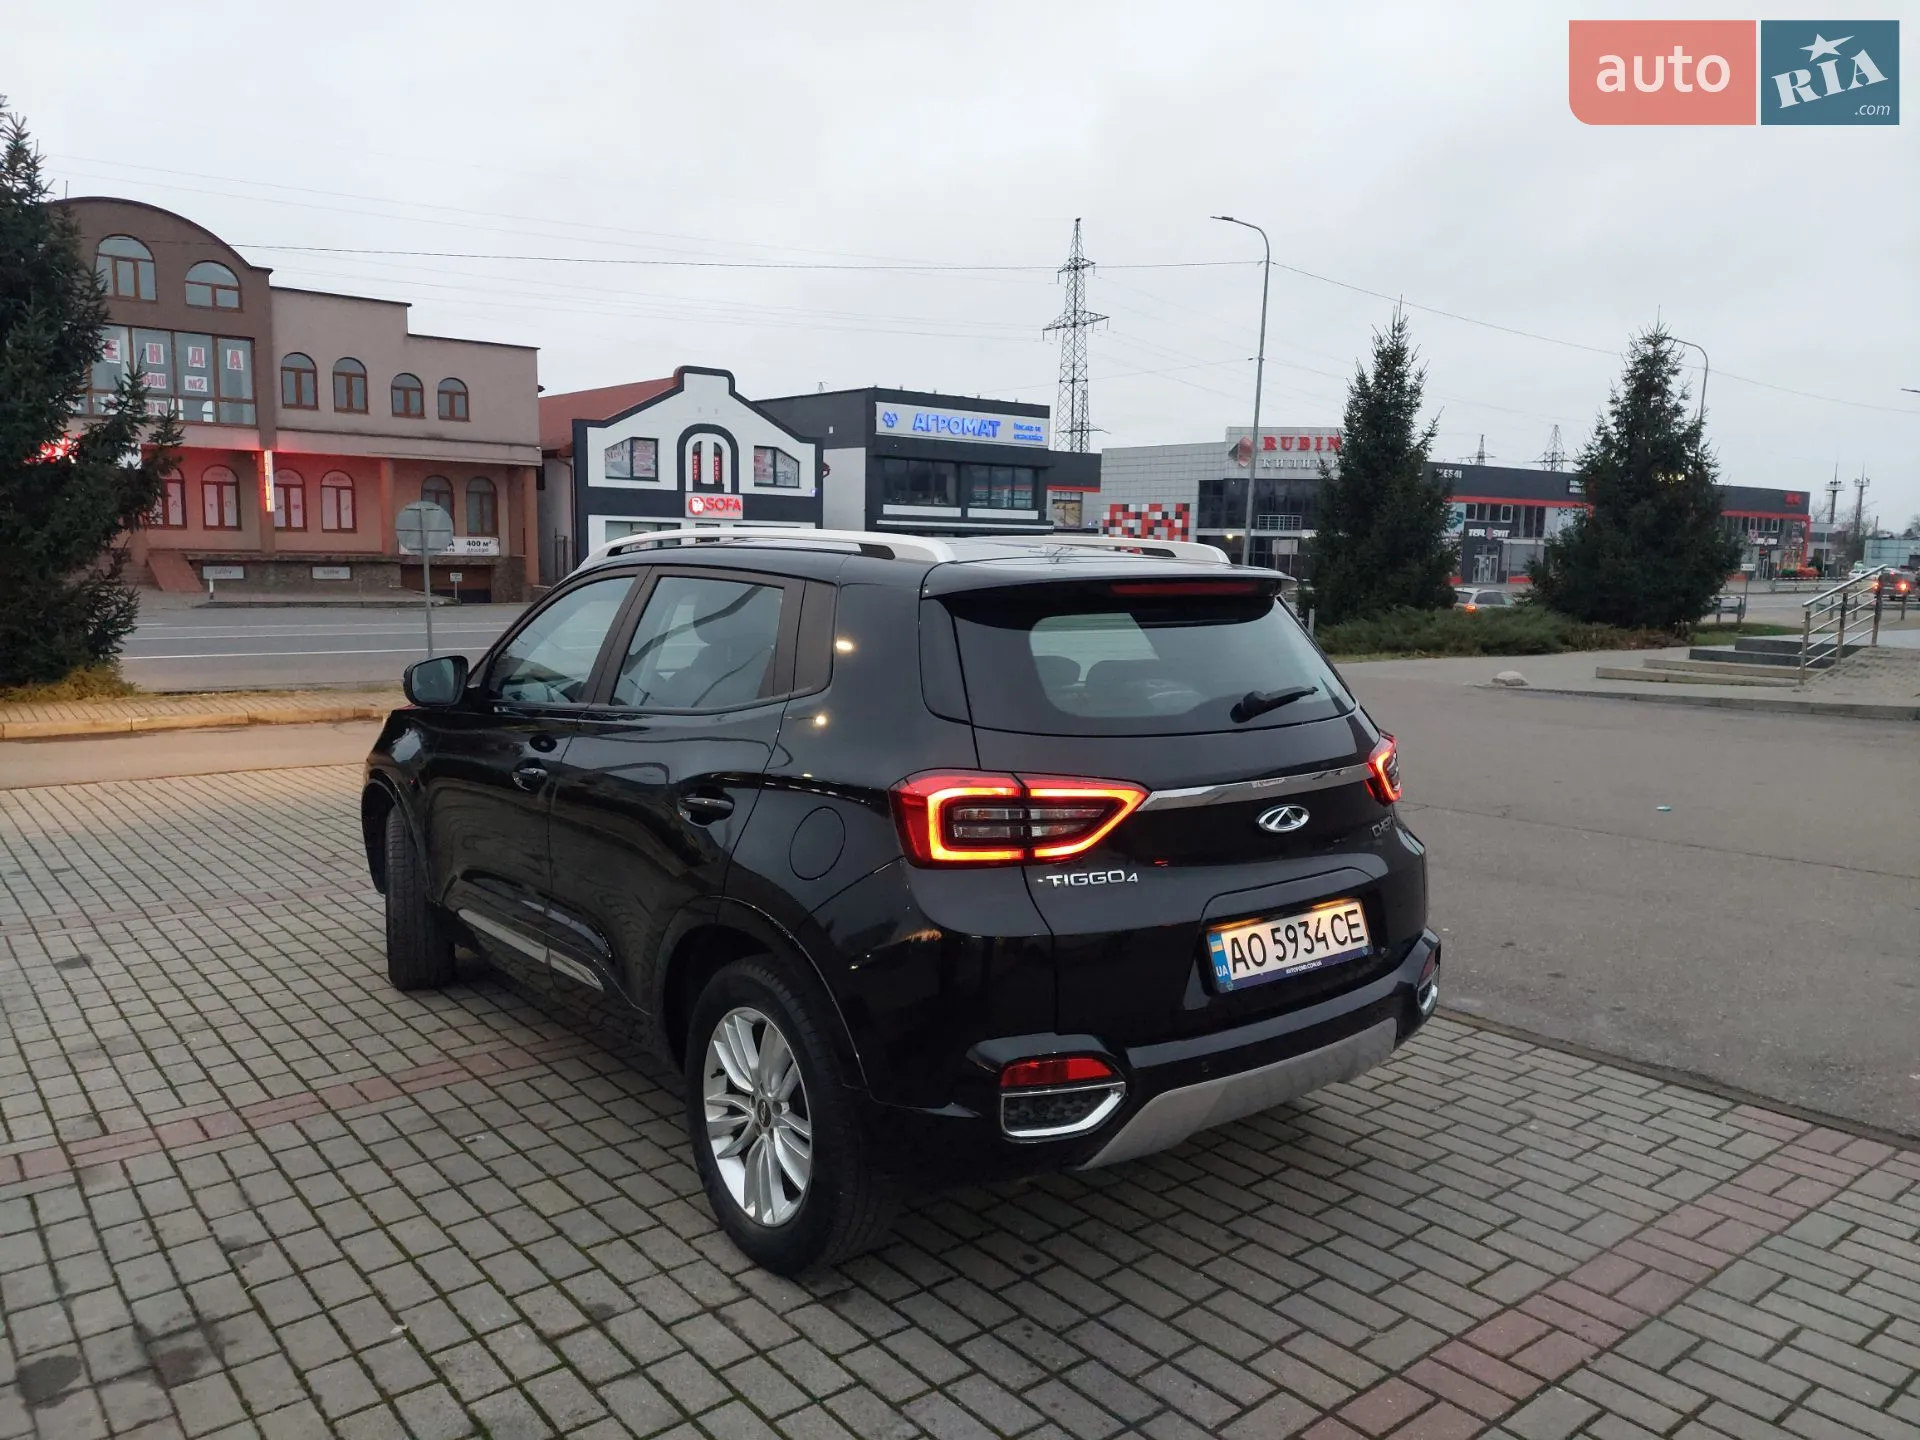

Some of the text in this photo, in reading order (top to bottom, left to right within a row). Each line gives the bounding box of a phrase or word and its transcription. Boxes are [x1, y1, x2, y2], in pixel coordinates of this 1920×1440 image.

[912, 412, 1001, 438] АГРОМАТ
[1263, 436, 1341, 451] RUBIN
[705, 497, 741, 511] SOFA
[1230, 908, 1365, 974] AO 5934 CE
[1216, 964, 1229, 977] UA
